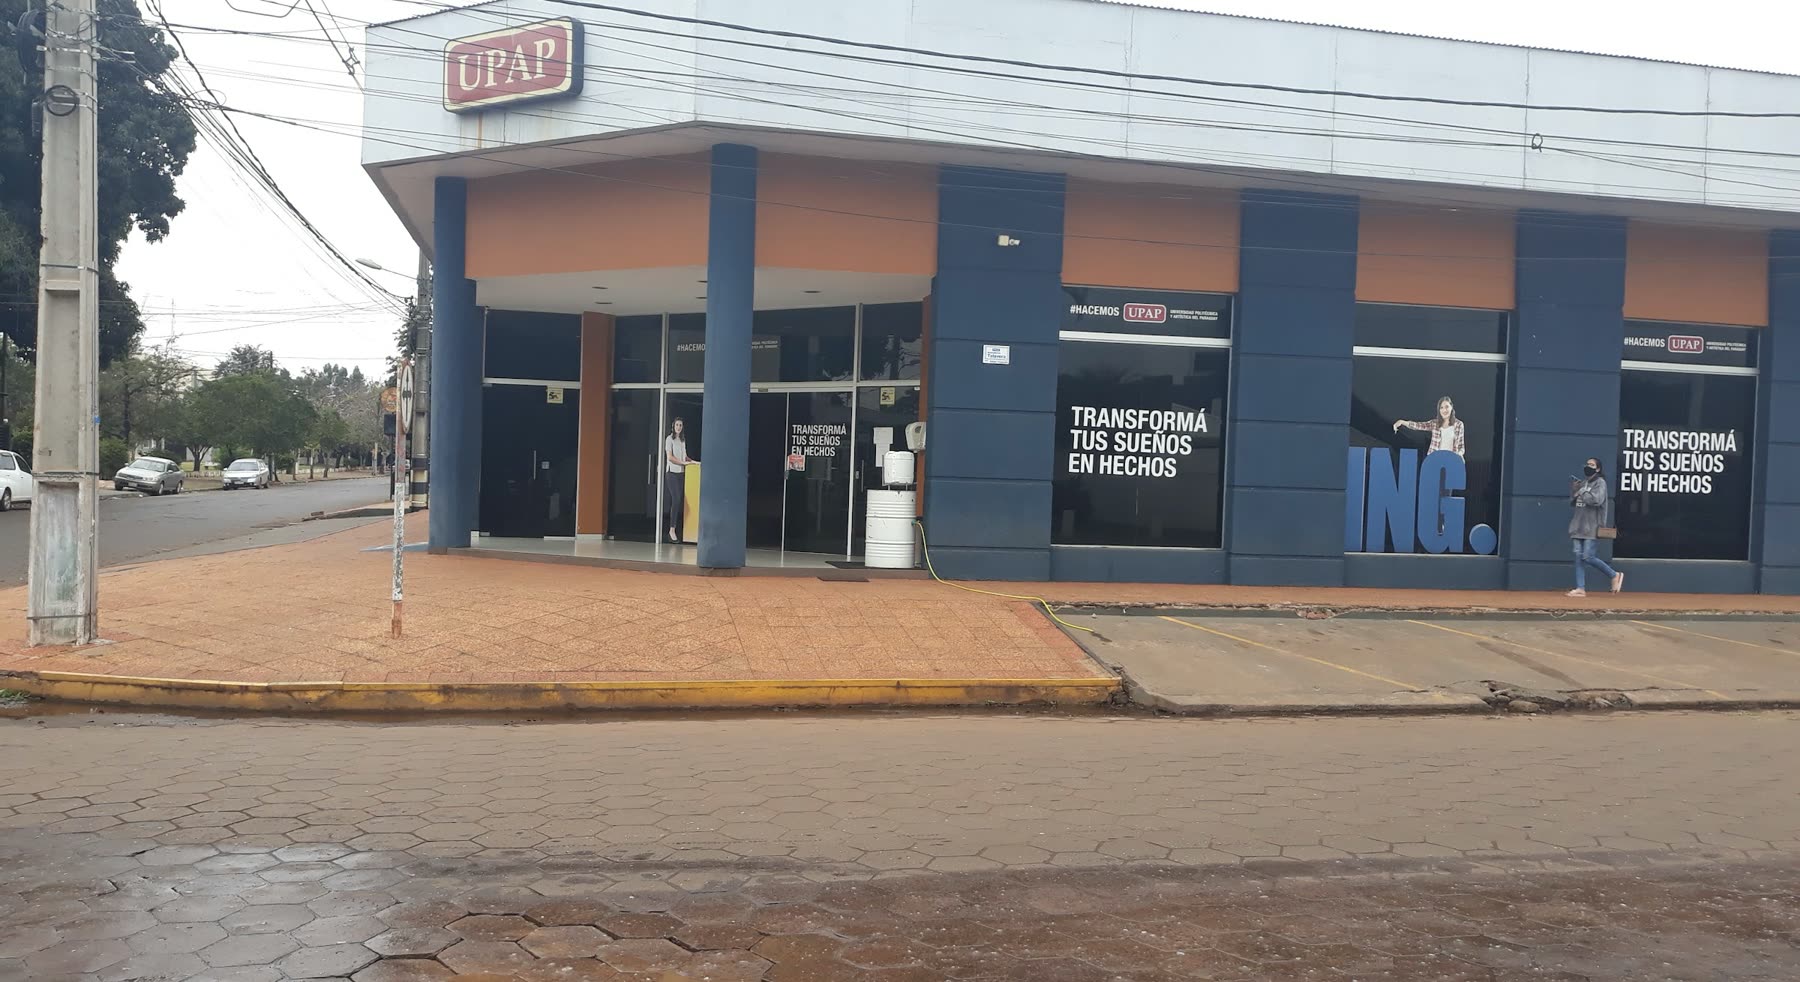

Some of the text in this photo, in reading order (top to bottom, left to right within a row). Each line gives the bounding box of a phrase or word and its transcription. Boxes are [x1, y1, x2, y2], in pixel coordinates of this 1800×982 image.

[457, 38, 556, 91] UPAP
[1070, 304, 1120, 316] #HACEMOS
[1128, 307, 1162, 319] UPAP
[677, 343, 705, 352] #HACEMO
[1624, 337, 1665, 347] #HACEMOS
[1672, 339, 1700, 349] UPAP
[1071, 406, 1208, 433] TRANSFORMÁ
[792, 423, 847, 435] TRANSFORMÁ
[792, 434, 841, 446] TUS SUEÑOS
[1070, 429, 1192, 455] TUS SUEÑOS
[1623, 429, 1737, 452] TRANSFORMÁ
[791, 446, 836, 457] EN HECHOS
[1068, 453, 1177, 478] EN HECHOS
[1623, 450, 1724, 473] TUS SUEÑOS
[1620, 472, 1712, 494] EN HECHOS
[1344, 447, 1497, 555] ING.
